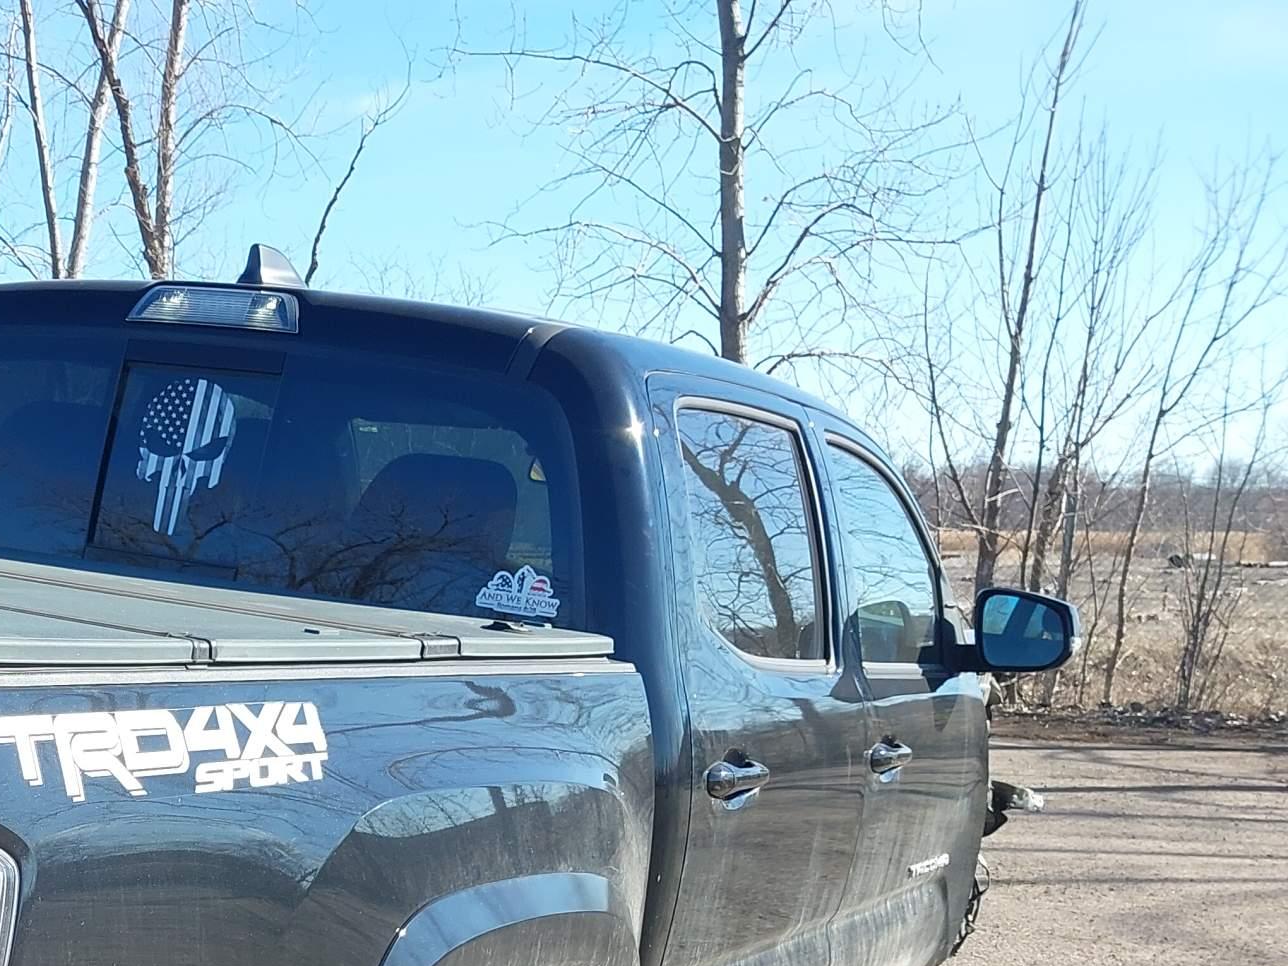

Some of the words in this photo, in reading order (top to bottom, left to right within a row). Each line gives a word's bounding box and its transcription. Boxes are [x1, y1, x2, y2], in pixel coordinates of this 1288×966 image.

[480, 592, 503, 602] AND
[506, 595, 522, 606] WE
[525, 597, 557, 610] KNOW
[194, 752, 329, 794] SPORT
